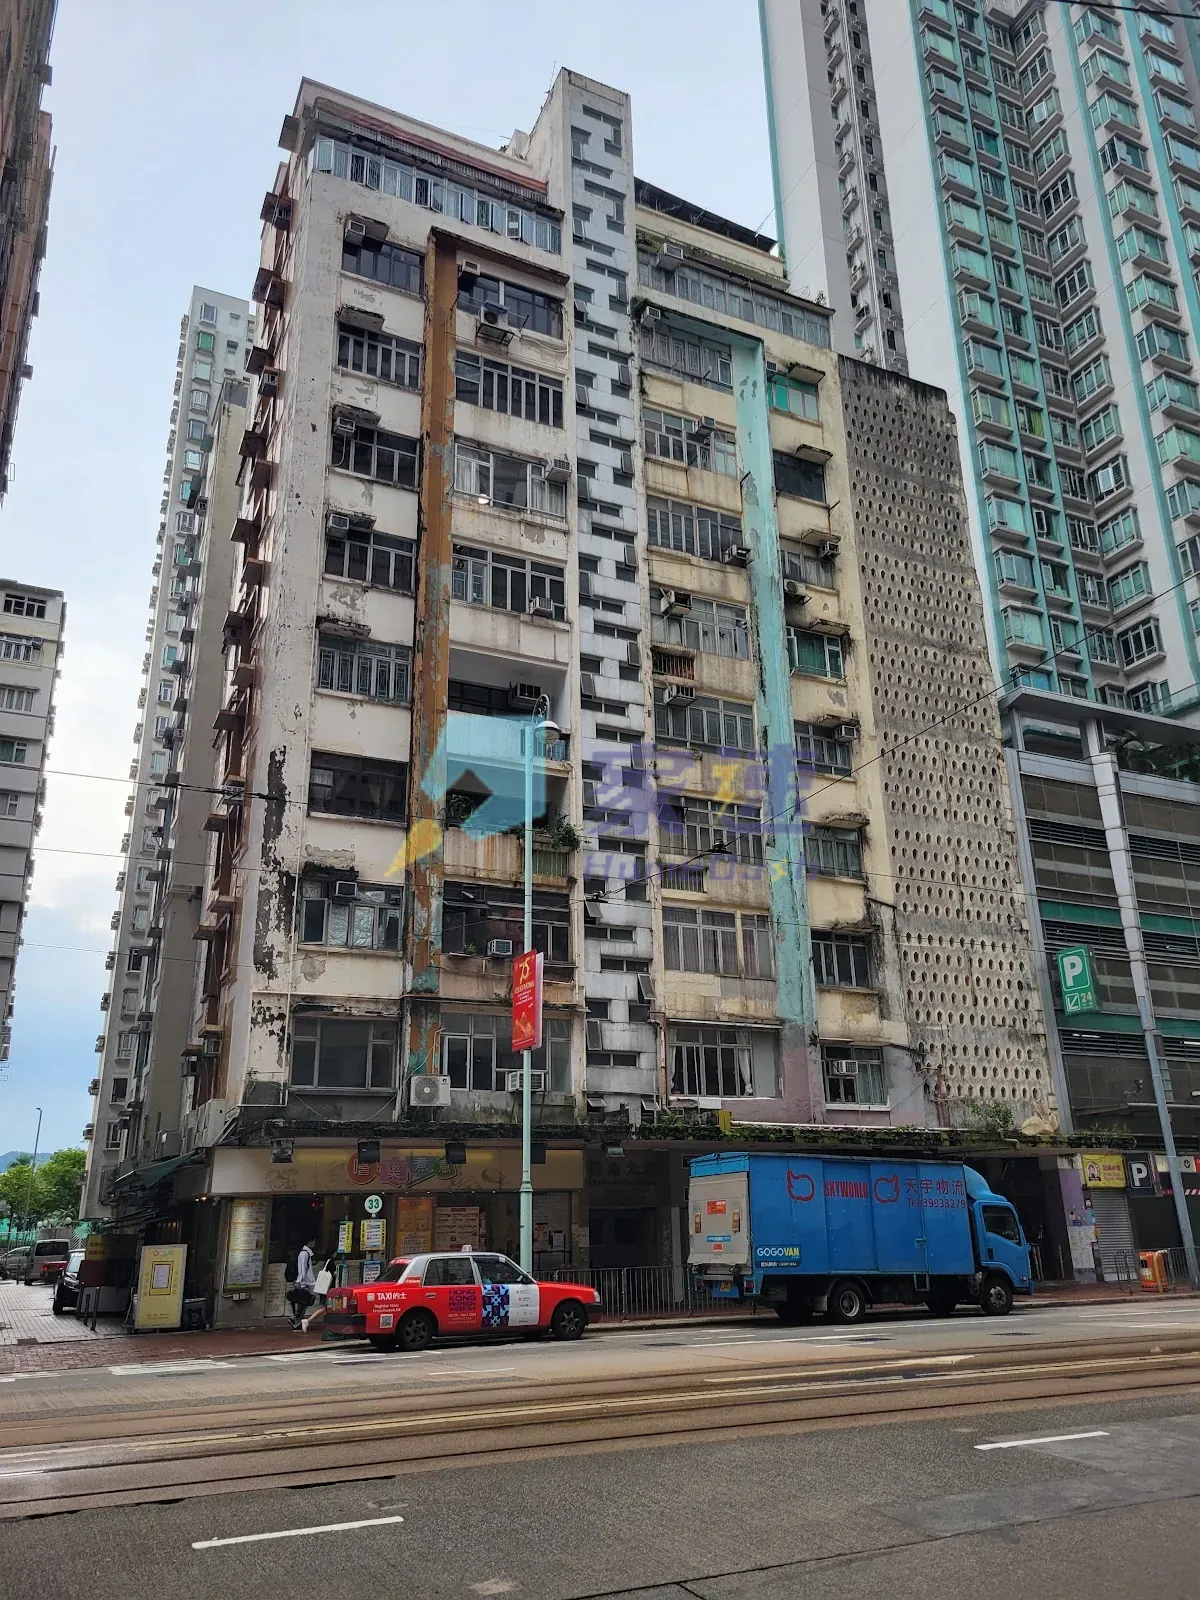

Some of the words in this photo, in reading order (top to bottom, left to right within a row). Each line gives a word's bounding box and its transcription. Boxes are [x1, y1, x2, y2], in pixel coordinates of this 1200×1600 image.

[518, 956, 531, 985] 75
[1063, 955, 1083, 987] P
[1080, 991, 1092, 1003] 24
[1131, 1162, 1148, 1187] P
[824, 1180, 869, 1199] SKYWORLD
[905, 1177, 965, 1196] 天宇物流
[368, 1198, 380, 1210] 33
[757, 1247, 800, 1257] GOGOVAN
[377, 1292, 392, 1301] TAXI
[392, 1292, 407, 1300] 的士
